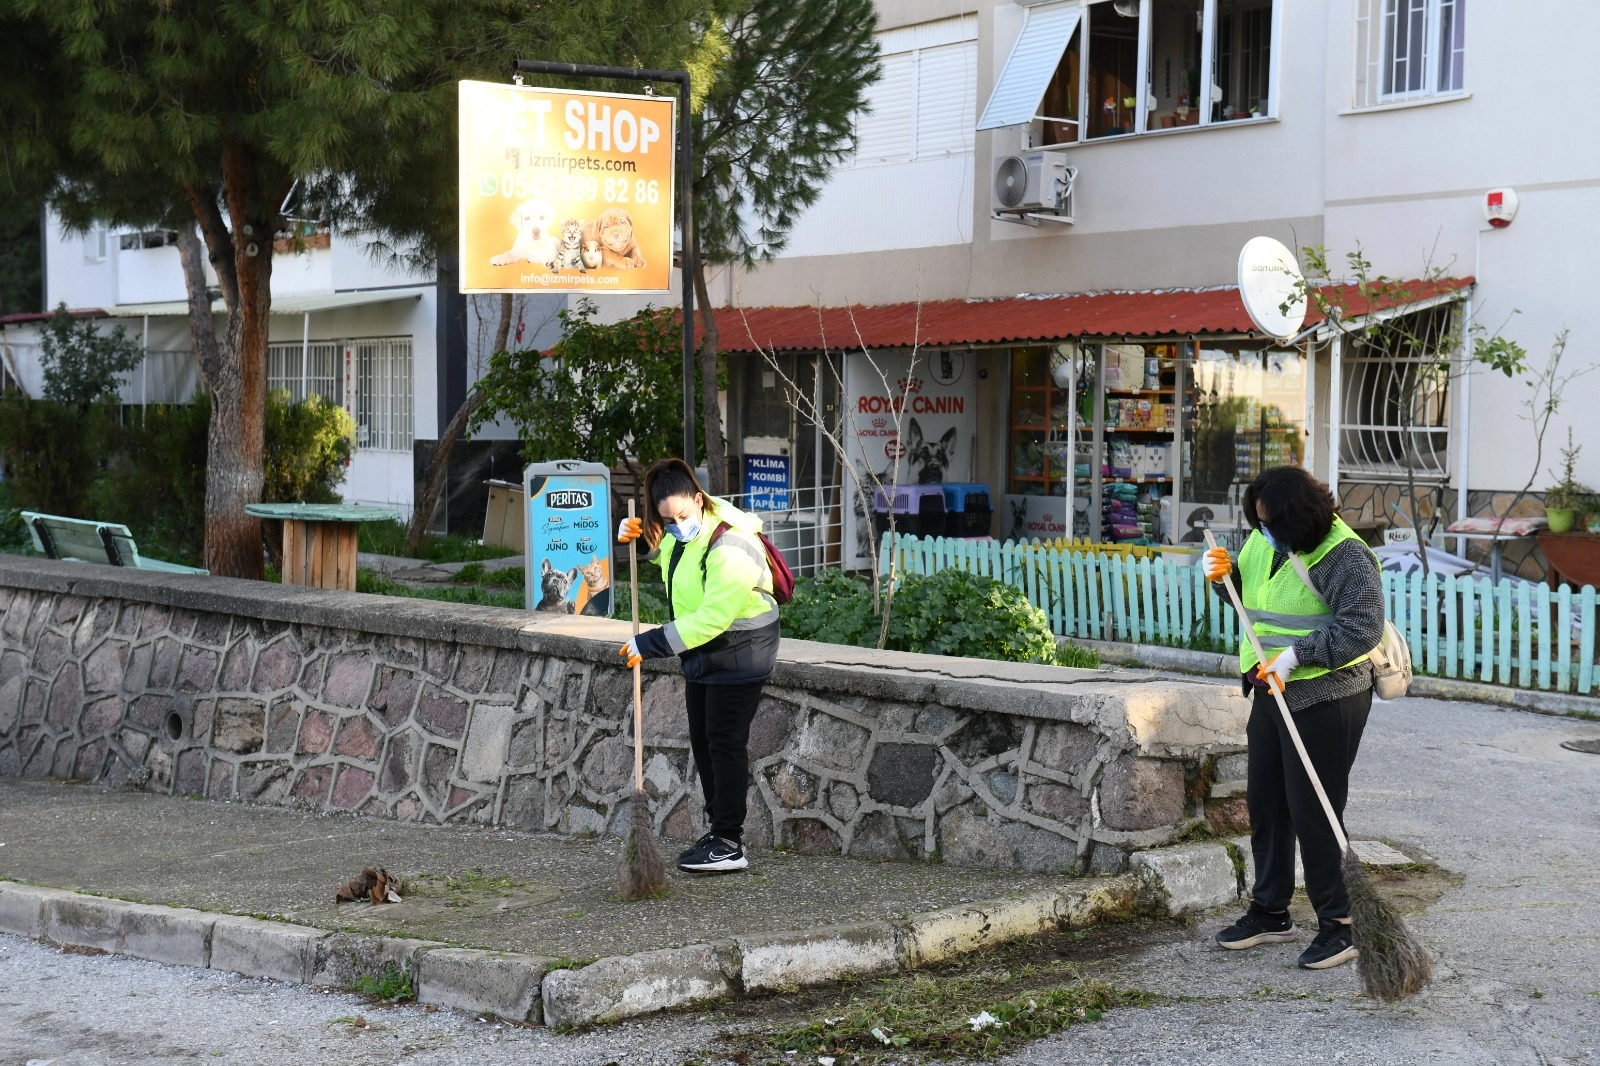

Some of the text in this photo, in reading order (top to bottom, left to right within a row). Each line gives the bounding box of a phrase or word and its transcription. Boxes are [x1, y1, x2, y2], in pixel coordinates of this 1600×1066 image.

[478, 97, 660, 154] PET SHOP
[529, 151, 637, 174] izmirpets.com
[501, 172, 659, 204] 0542 769 82 86
[520, 273, 619, 287] info@izmirpets.com
[858, 395, 964, 414] ROYAL CANIN
[750, 485, 787, 497] BAKIMI
[749, 498, 788, 510] YAPILIR
[1028, 522, 1046, 532] ROYAL
[1389, 532, 1410, 541] Rico
[545, 542, 568, 551] JUNO
[576, 541, 598, 554] Rico
